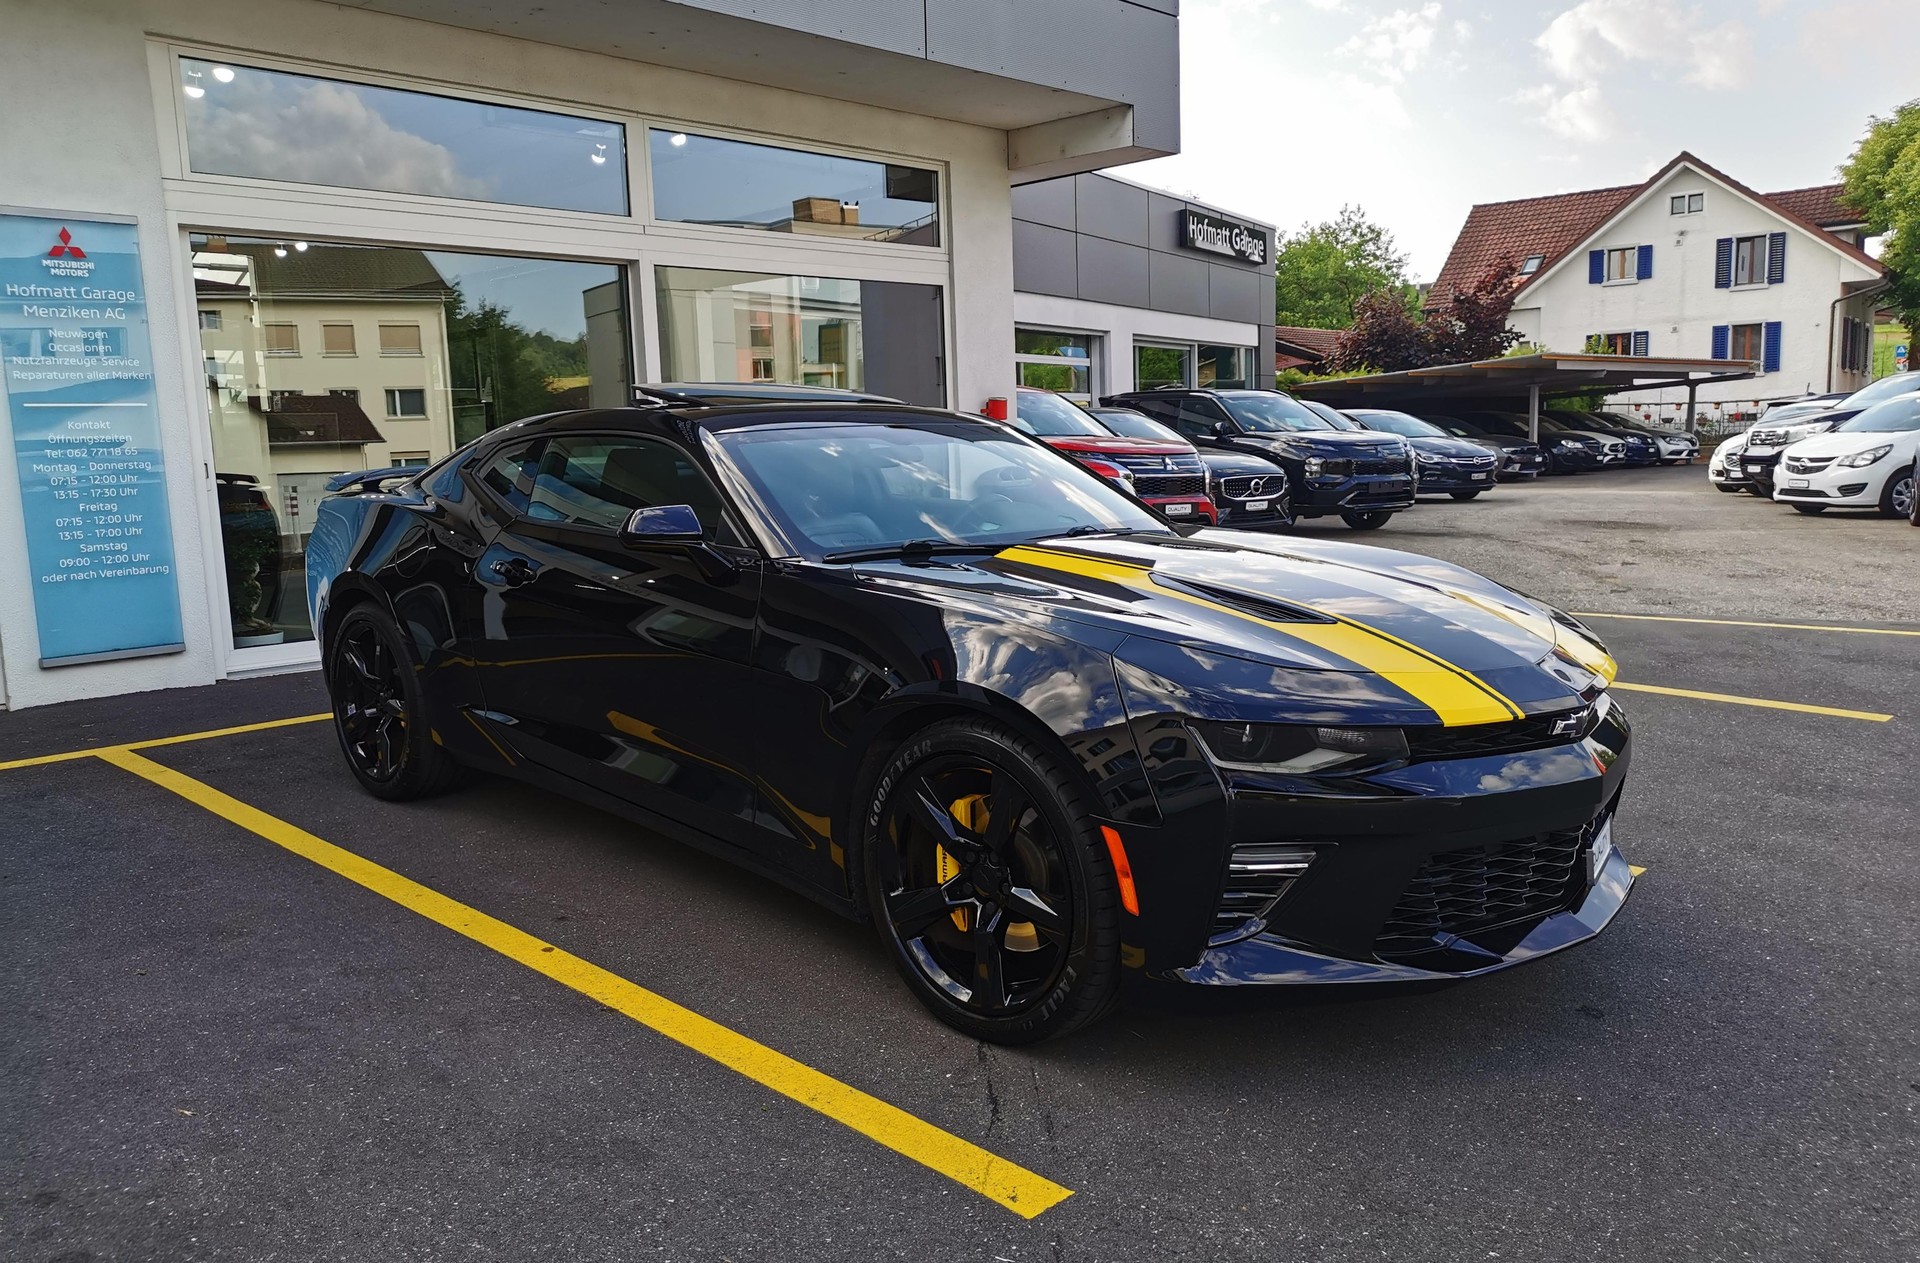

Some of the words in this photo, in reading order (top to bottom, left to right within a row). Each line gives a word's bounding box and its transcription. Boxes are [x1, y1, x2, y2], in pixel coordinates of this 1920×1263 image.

[1189, 215, 1231, 248] Hofmatt
[1231, 228, 1265, 259] Garage
[42, 259, 95, 270] MITSUBISHI
[51, 268, 89, 277] MOTORS
[6, 284, 77, 298] Hofmatt
[81, 287, 135, 303] Garage
[23, 305, 100, 319] Menziken
[104, 308, 126, 319] AG
[48, 329, 108, 341] Neuwagen
[48, 343, 112, 352] Occasionen
[13, 356, 97, 367] Nutzfahrzeuge
[101, 357, 140, 366] Service
[13, 370, 85, 382] Reparaturen
[87, 370, 109, 380] aller
[112, 371, 151, 380] Marken
[67, 421, 111, 430] Kontakt
[48, 432, 132, 445] Öffnungszeiten
[66, 448, 88, 457] 062
[91, 447, 108, 457] 771
[109, 447, 121, 456] 18
[125, 446, 138, 456] 65
[33, 463, 77, 474] Montag
[89, 460, 152, 471] Donnerstag
[51, 476, 78, 486] 07:15
[89, 475, 117, 484] 12:00
[119, 474, 138, 483] Uhr
[53, 490, 79, 499] 13:15
[90, 488, 117, 498] 17:30
[119, 487, 138, 496] Uhr
[79, 502, 118, 513] Freitag
[55, 517, 83, 527] 07:15
[93, 515, 121, 525] 12:00
[124, 513, 143, 523] Uhr
[58, 531, 84, 540] 13:15
[95, 528, 122, 538] 17:00
[125, 527, 143, 536] Uhr
[79, 541, 128, 553] Samstag
[59, 558, 91, 568] 09:00
[101, 554, 129, 565] 12:00
[131, 552, 150, 562] Uhr
[42, 572, 67, 583] oder
[70, 570, 97, 580] nach
[99, 564, 170, 579] Vereinbarung
[870, 740, 932, 827] GOODYEAR
